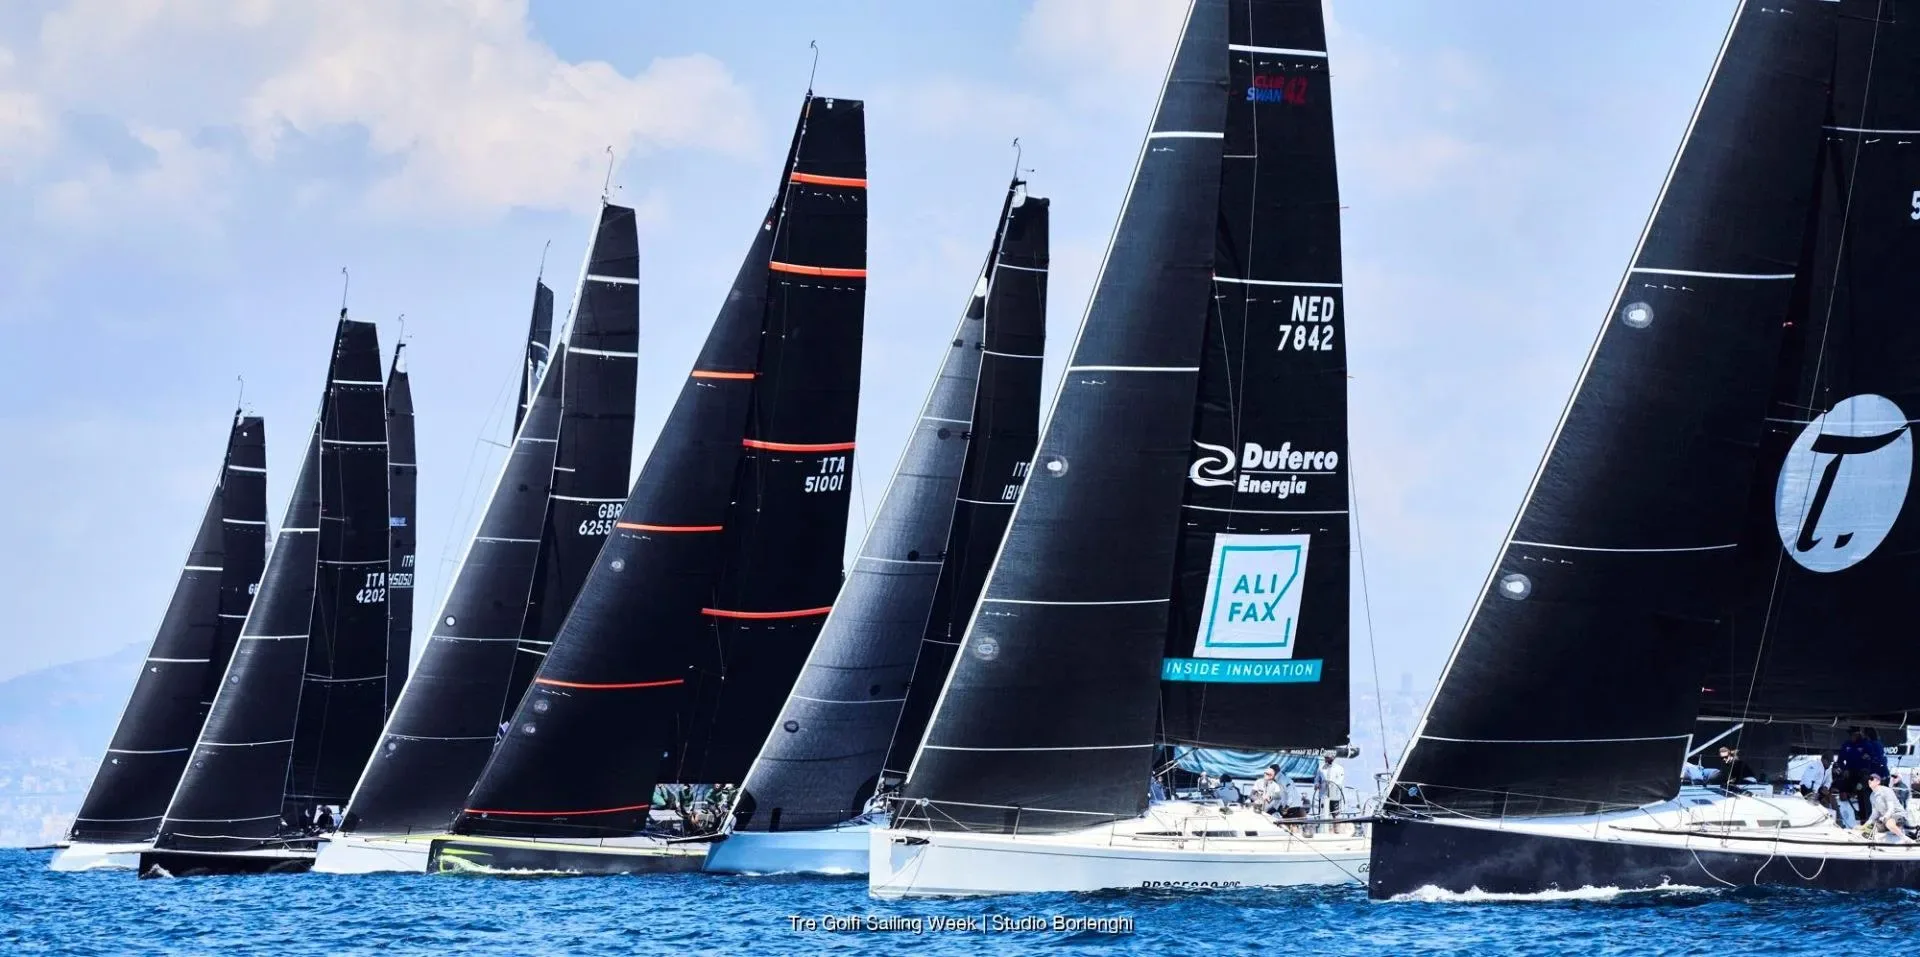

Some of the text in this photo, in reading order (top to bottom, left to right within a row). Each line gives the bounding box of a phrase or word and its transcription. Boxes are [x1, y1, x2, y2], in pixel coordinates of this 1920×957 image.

[1246, 76, 1308, 104] SWAN 42
[1291, 295, 1335, 322] NED
[1277, 324, 1335, 351] 7842
[820, 456, 846, 474] ITA
[1241, 442, 1339, 470] Duferco
[804, 474, 844, 493] 51001
[1237, 475, 1307, 499] Energia
[598, 503, 623, 519] GBR
[401, 555, 414, 568] ITA
[365, 572, 385, 588] ITA
[1232, 574, 1278, 594] ALI
[356, 588, 385, 604] 4202
[1228, 602, 1276, 622] FAX
[1166, 662, 1314, 676] INSIDE INNOVATION
